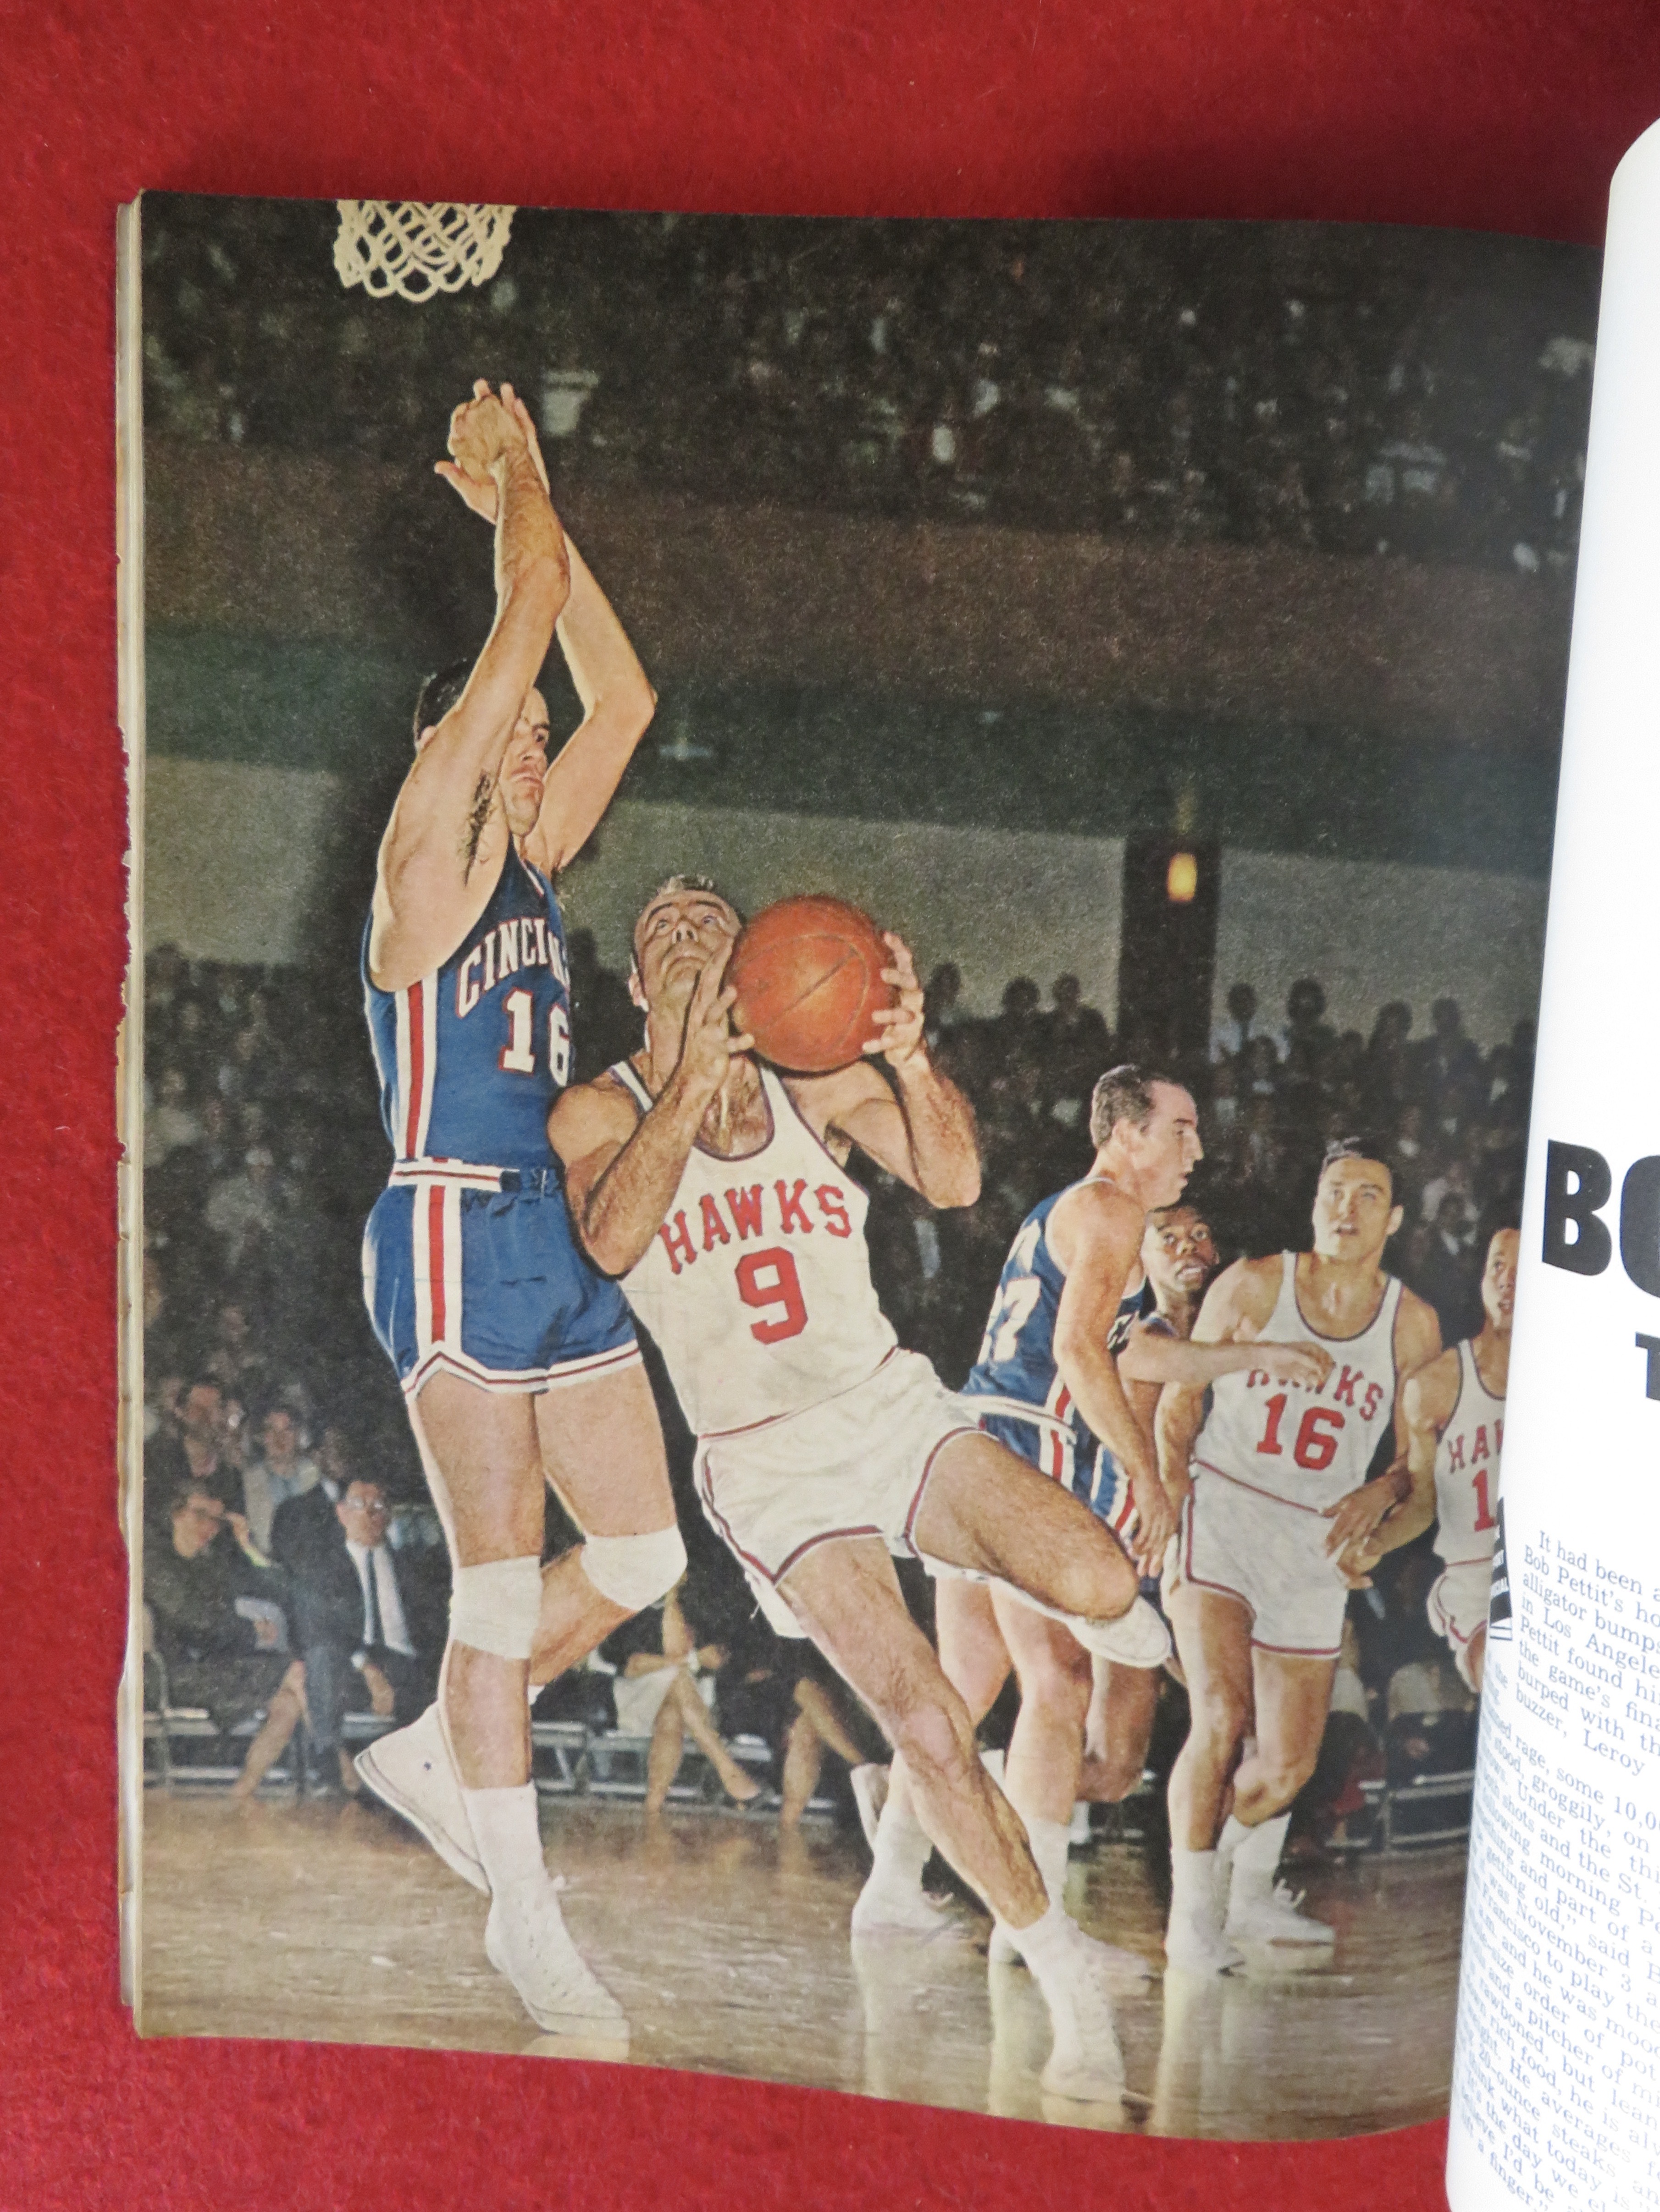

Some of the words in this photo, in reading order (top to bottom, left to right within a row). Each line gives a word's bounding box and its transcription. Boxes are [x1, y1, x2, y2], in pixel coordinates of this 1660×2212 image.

[498, 986, 570, 1088] 16
[657, 1178, 852, 1275] HAWKS
[734, 1245, 808, 1345] 9
[1256, 1393, 1345, 1471] 16
[1446, 1418, 1505, 1474] HA
[1522, 1573, 1587, 1620] alligator
[1524, 1544, 1549, 1576] Bob
[1557, 1565, 1624, 1613] Pettit's
[1539, 1530, 1550, 1553] It
[1556, 1540, 1587, 1572] had
[1595, 1558, 1643, 1595] been
[1520, 1614, 1559, 1656] Pettit
[1567, 1647, 1623, 1690] found
[1521, 1591, 1533, 1615] in
[1543, 1607, 1572, 1638] Los
[1517, 1659, 1569, 1712] burped
[1580, 1706, 1625, 1741] with
[1519, 1639, 1539, 1667] the
[1548, 1665, 1610, 1709] game's
[1515, 1681, 1567, 1738] buzzer,
[1583, 1728, 1645, 1776] Leroy
[1516, 1735, 1549, 1775] rage,
[1556, 1768, 1604, 1805] some
[1614, 1796, 1660, 1831] 10,0
[1517, 1779, 1566, 1830] Under
[1580, 1827, 1611, 1859] the
[1531, 1774, 1610, 1838] groggily,
[1623, 1831, 1650, 1853] on
[1520, 1859, 1547, 1891] and
[1557, 1887, 1597, 1924] part
[1607, 1921, 1630, 1942] of
[1539, 1828, 1571, 1860] and
[1578, 1850, 1611, 1883] the
[1618, 1872, 1647, 1903] St.
[1539, 1850, 1621, 1917] morning
[1516, 1897, 1608, 1978] November
[1588, 1933, 1631, 1969] said
[1501, 1936, 1527, 1969] and
[1533, 1960, 1553, 1989] he
[1559, 1985, 1597, 2021] was
[1523, 1981, 1570, 2025] order
[1584, 2029, 1605, 2050] of
[1547, 1950, 1564, 1974] to
[1570, 1970, 1615, 2008] play
[1488, 1966, 1510, 2000] and
[1514, 1996, 1523, 2012] a
[1528, 2008, 1594, 2066] pitcher
[1601, 2064, 1624, 2085] of
[1510, 2055, 1531, 2089] He
[1541, 2091, 1631, 2163] averages
[1521, 2046, 1562, 2096] food,
[1570, 2085, 1594, 2115] he
[1602, 2107, 1618, 2132] is
[1562, 2054, 1595, 2094] but
[1610, 2087, 1658, 2131] lean
[1486, 2101, 1506, 2135] the
[1511, 2132, 1543, 2169] day
[1551, 2168, 1579, 2199] we
[1500, 2096, 1538, 2144] what
[1547, 2139, 1602, 2191] today
[1552, 2124, 1616, 2178] steaks
[1534, 2172, 1554, 2203] be
